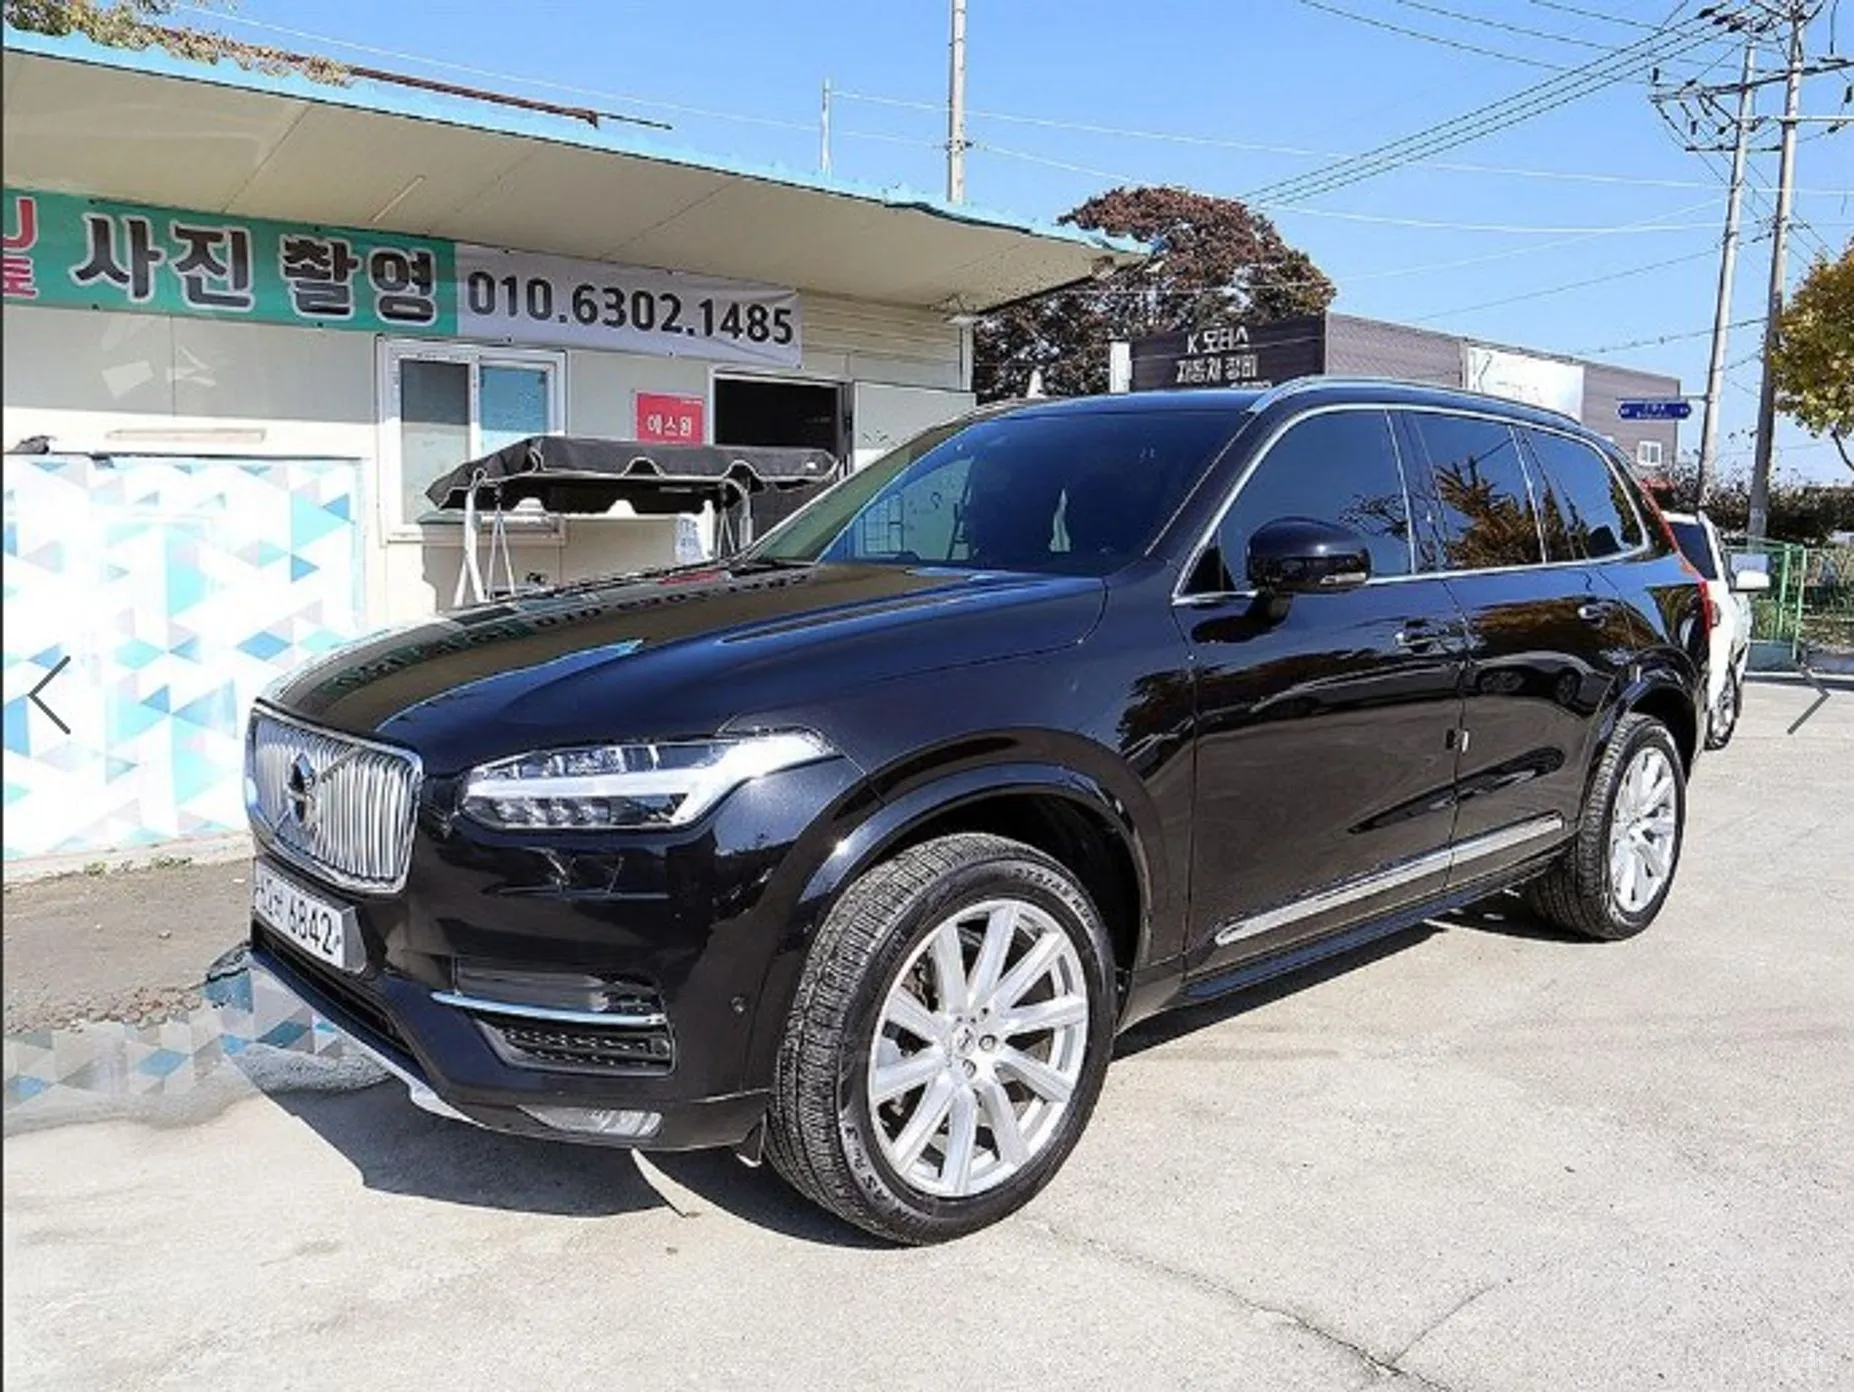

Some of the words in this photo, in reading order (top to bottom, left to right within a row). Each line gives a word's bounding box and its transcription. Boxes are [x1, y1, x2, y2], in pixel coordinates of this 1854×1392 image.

[72, 215, 253, 309] 사진
[280, 235, 436, 323] 촬영
[467, 270, 793, 345] 010.6302.1485
[1202, 326, 1251, 354] 모터스
[288, 896, 333, 956] 6842
